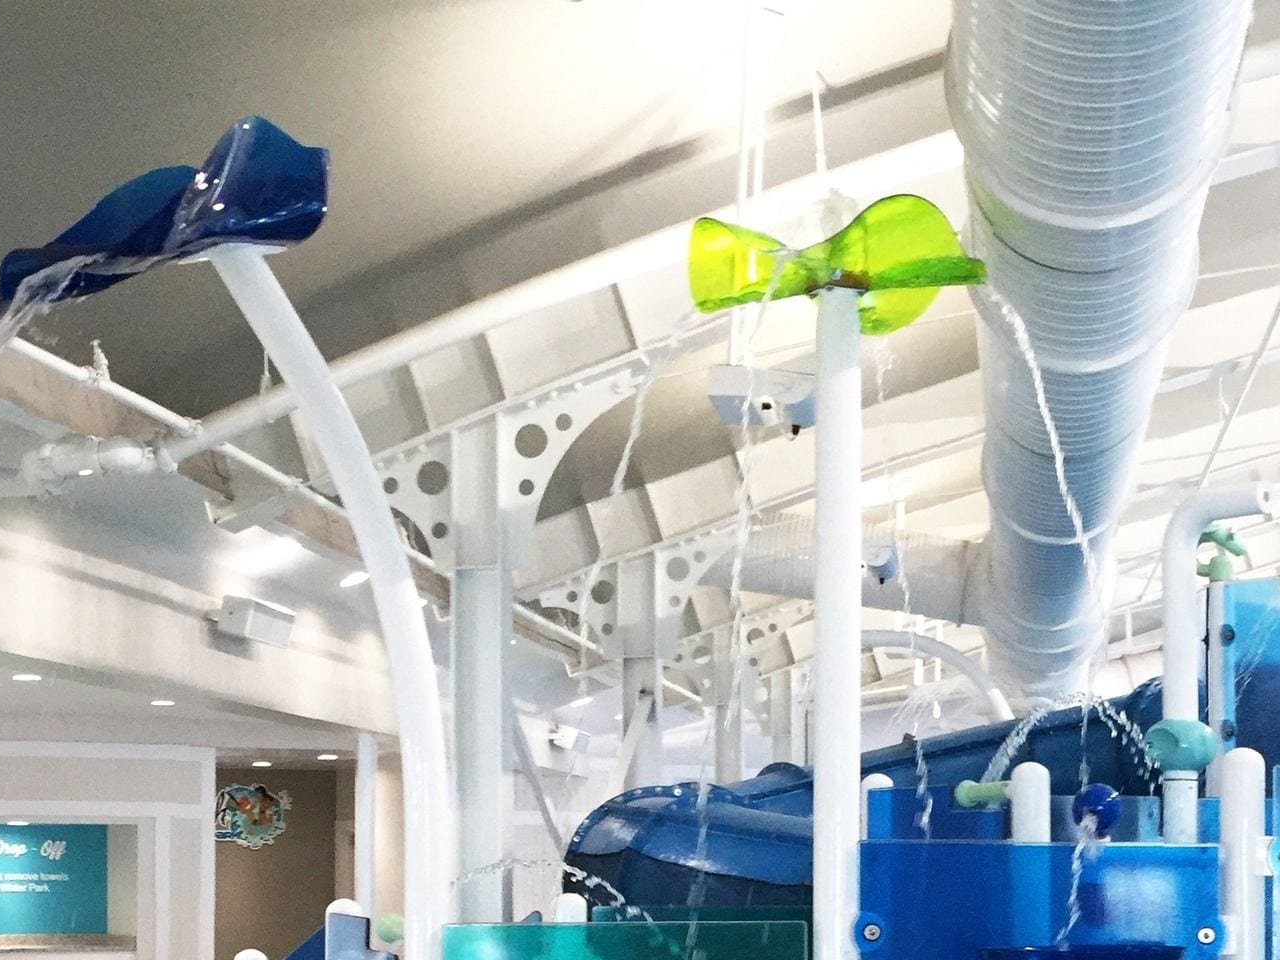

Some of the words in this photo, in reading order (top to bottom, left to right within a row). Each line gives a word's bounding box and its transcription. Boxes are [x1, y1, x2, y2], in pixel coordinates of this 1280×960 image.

[40, 839, 67, 861] Off
[4, 873, 39, 881] remove
[40, 872, 70, 881] towels
[0, 884, 27, 893] Water
[28, 882, 51, 893] Park
